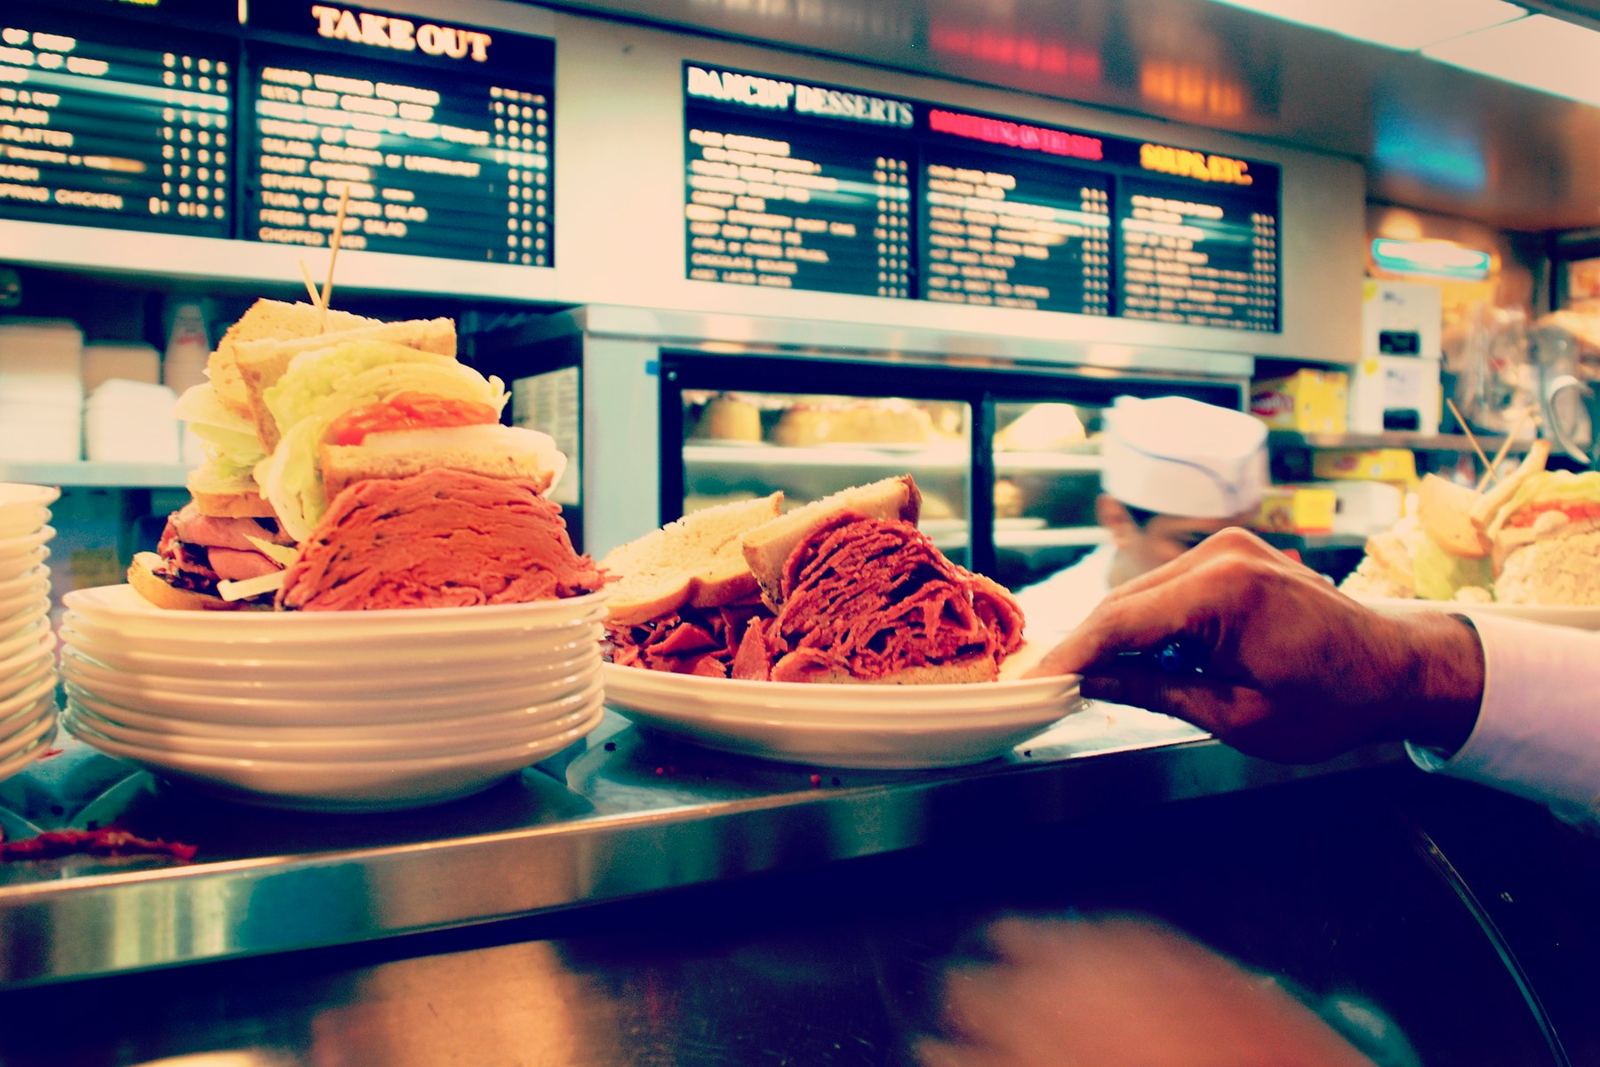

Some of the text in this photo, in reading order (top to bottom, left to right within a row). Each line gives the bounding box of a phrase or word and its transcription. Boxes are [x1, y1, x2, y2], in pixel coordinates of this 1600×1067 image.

[312, 5, 492, 62] TAKE OUT
[795, 84, 914, 128] DESSERTS
